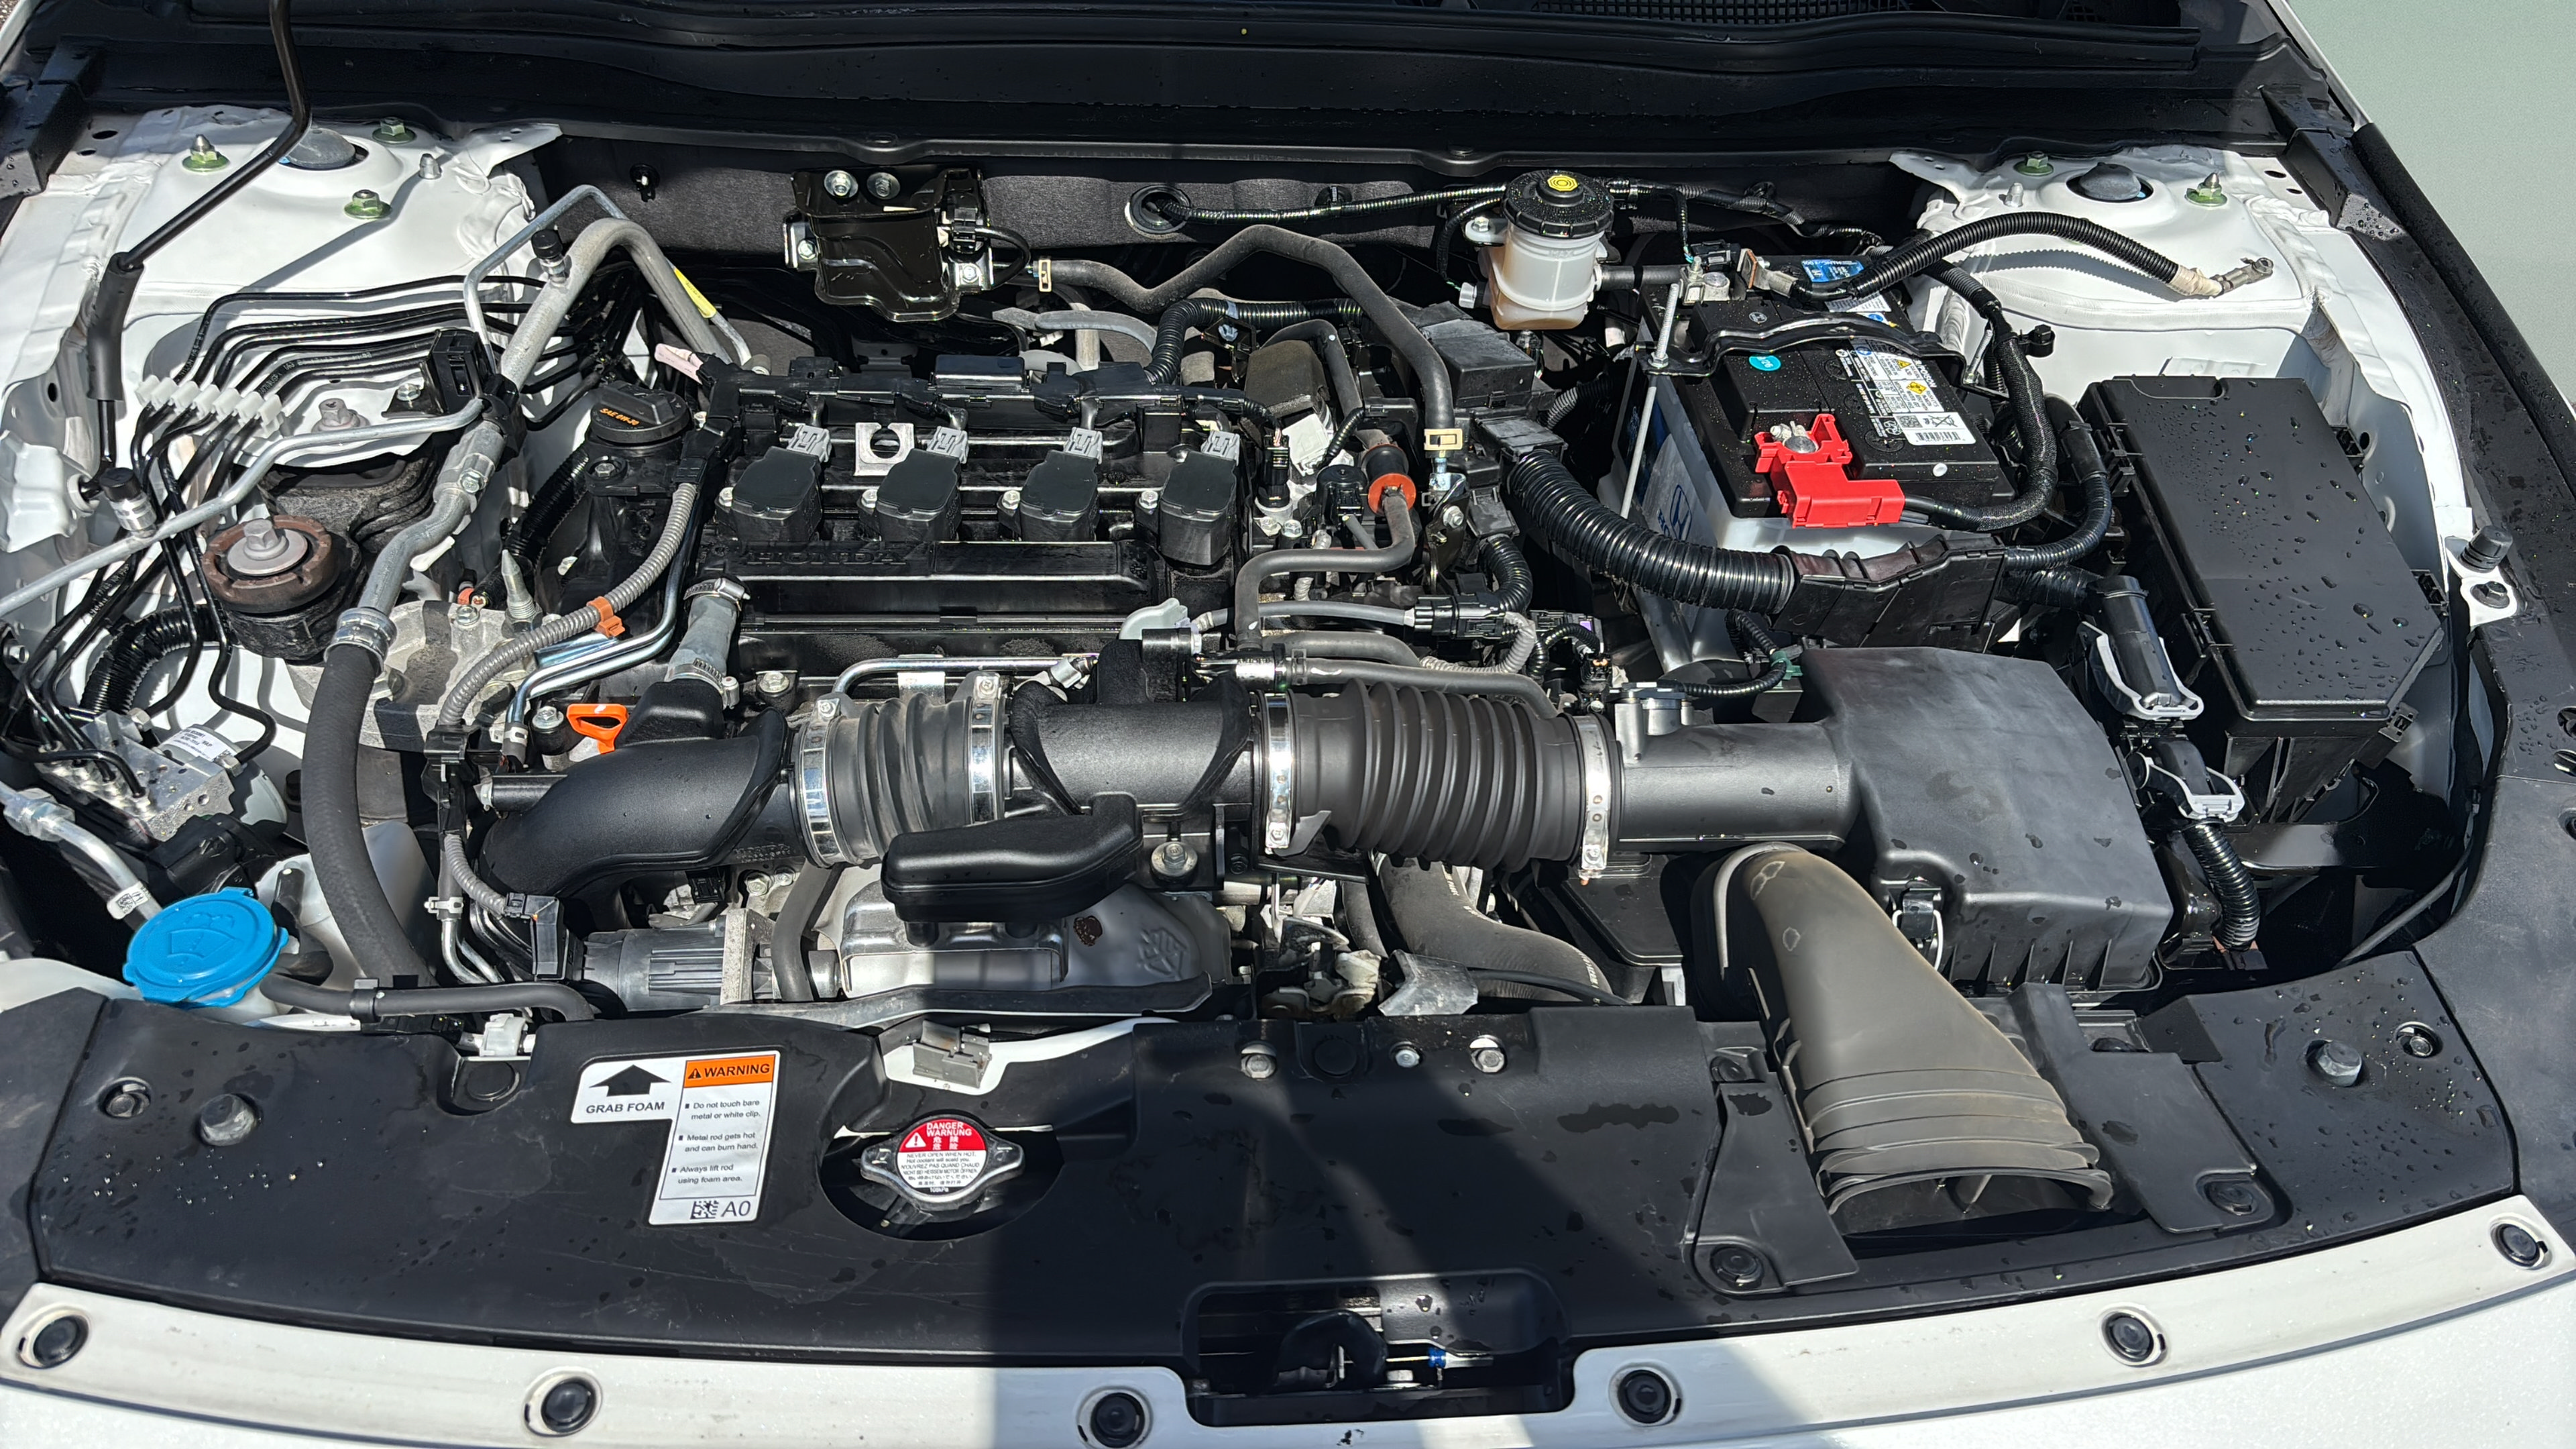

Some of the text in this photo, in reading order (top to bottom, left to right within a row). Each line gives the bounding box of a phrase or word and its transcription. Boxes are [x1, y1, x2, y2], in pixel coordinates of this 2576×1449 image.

[600, 408, 618, 417] SAE
[746, 551, 907, 565] HONDA
[704, 1063, 771, 1078] WARNING
[586, 1102, 665, 1114] GRAB FOAM
[720, 1099, 741, 1108] touch
[742, 1099, 760, 1107] bare
[691, 1112, 712, 1120] metal
[745, 1110, 761, 1119] clip.
[926, 1122, 964, 1130] DANGER
[724, 1133, 742, 1142] gets
[926, 1129, 972, 1137] WARNUNG
[680, 1165, 708, 1174] Always
[678, 1176, 699, 1185] using
